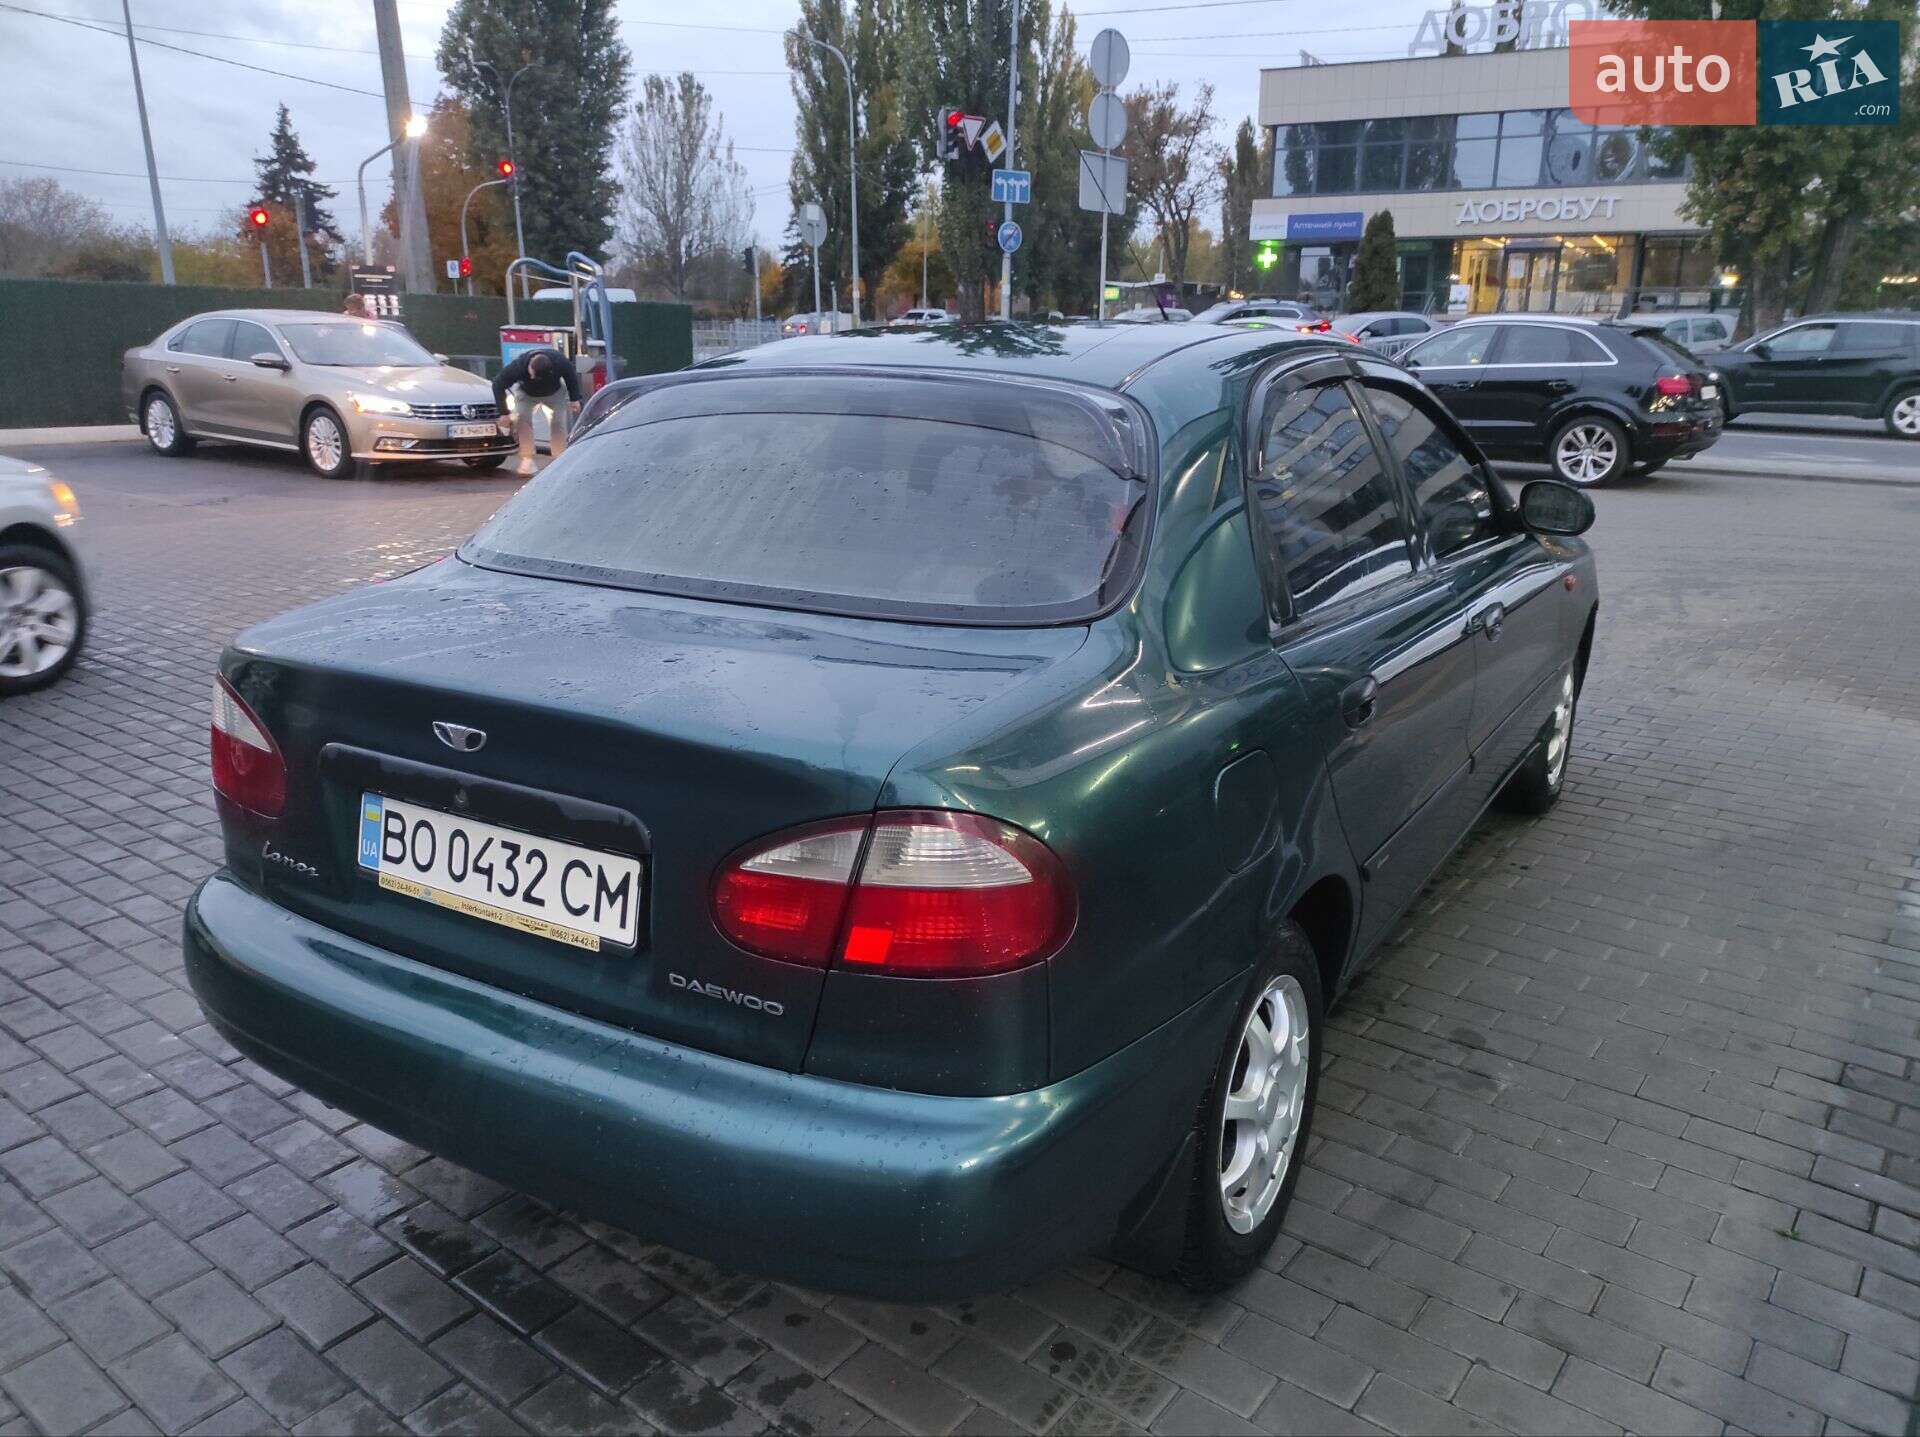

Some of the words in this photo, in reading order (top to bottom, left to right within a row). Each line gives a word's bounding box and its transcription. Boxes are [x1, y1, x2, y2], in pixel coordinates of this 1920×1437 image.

[1456, 194, 1624, 226] ДОБРОБУТ
[362, 838, 379, 859] UA
[382, 809, 437, 873] BO
[447, 828, 548, 908] 0432
[560, 859, 631, 930] CM
[668, 972, 784, 1016] DAEWOO
